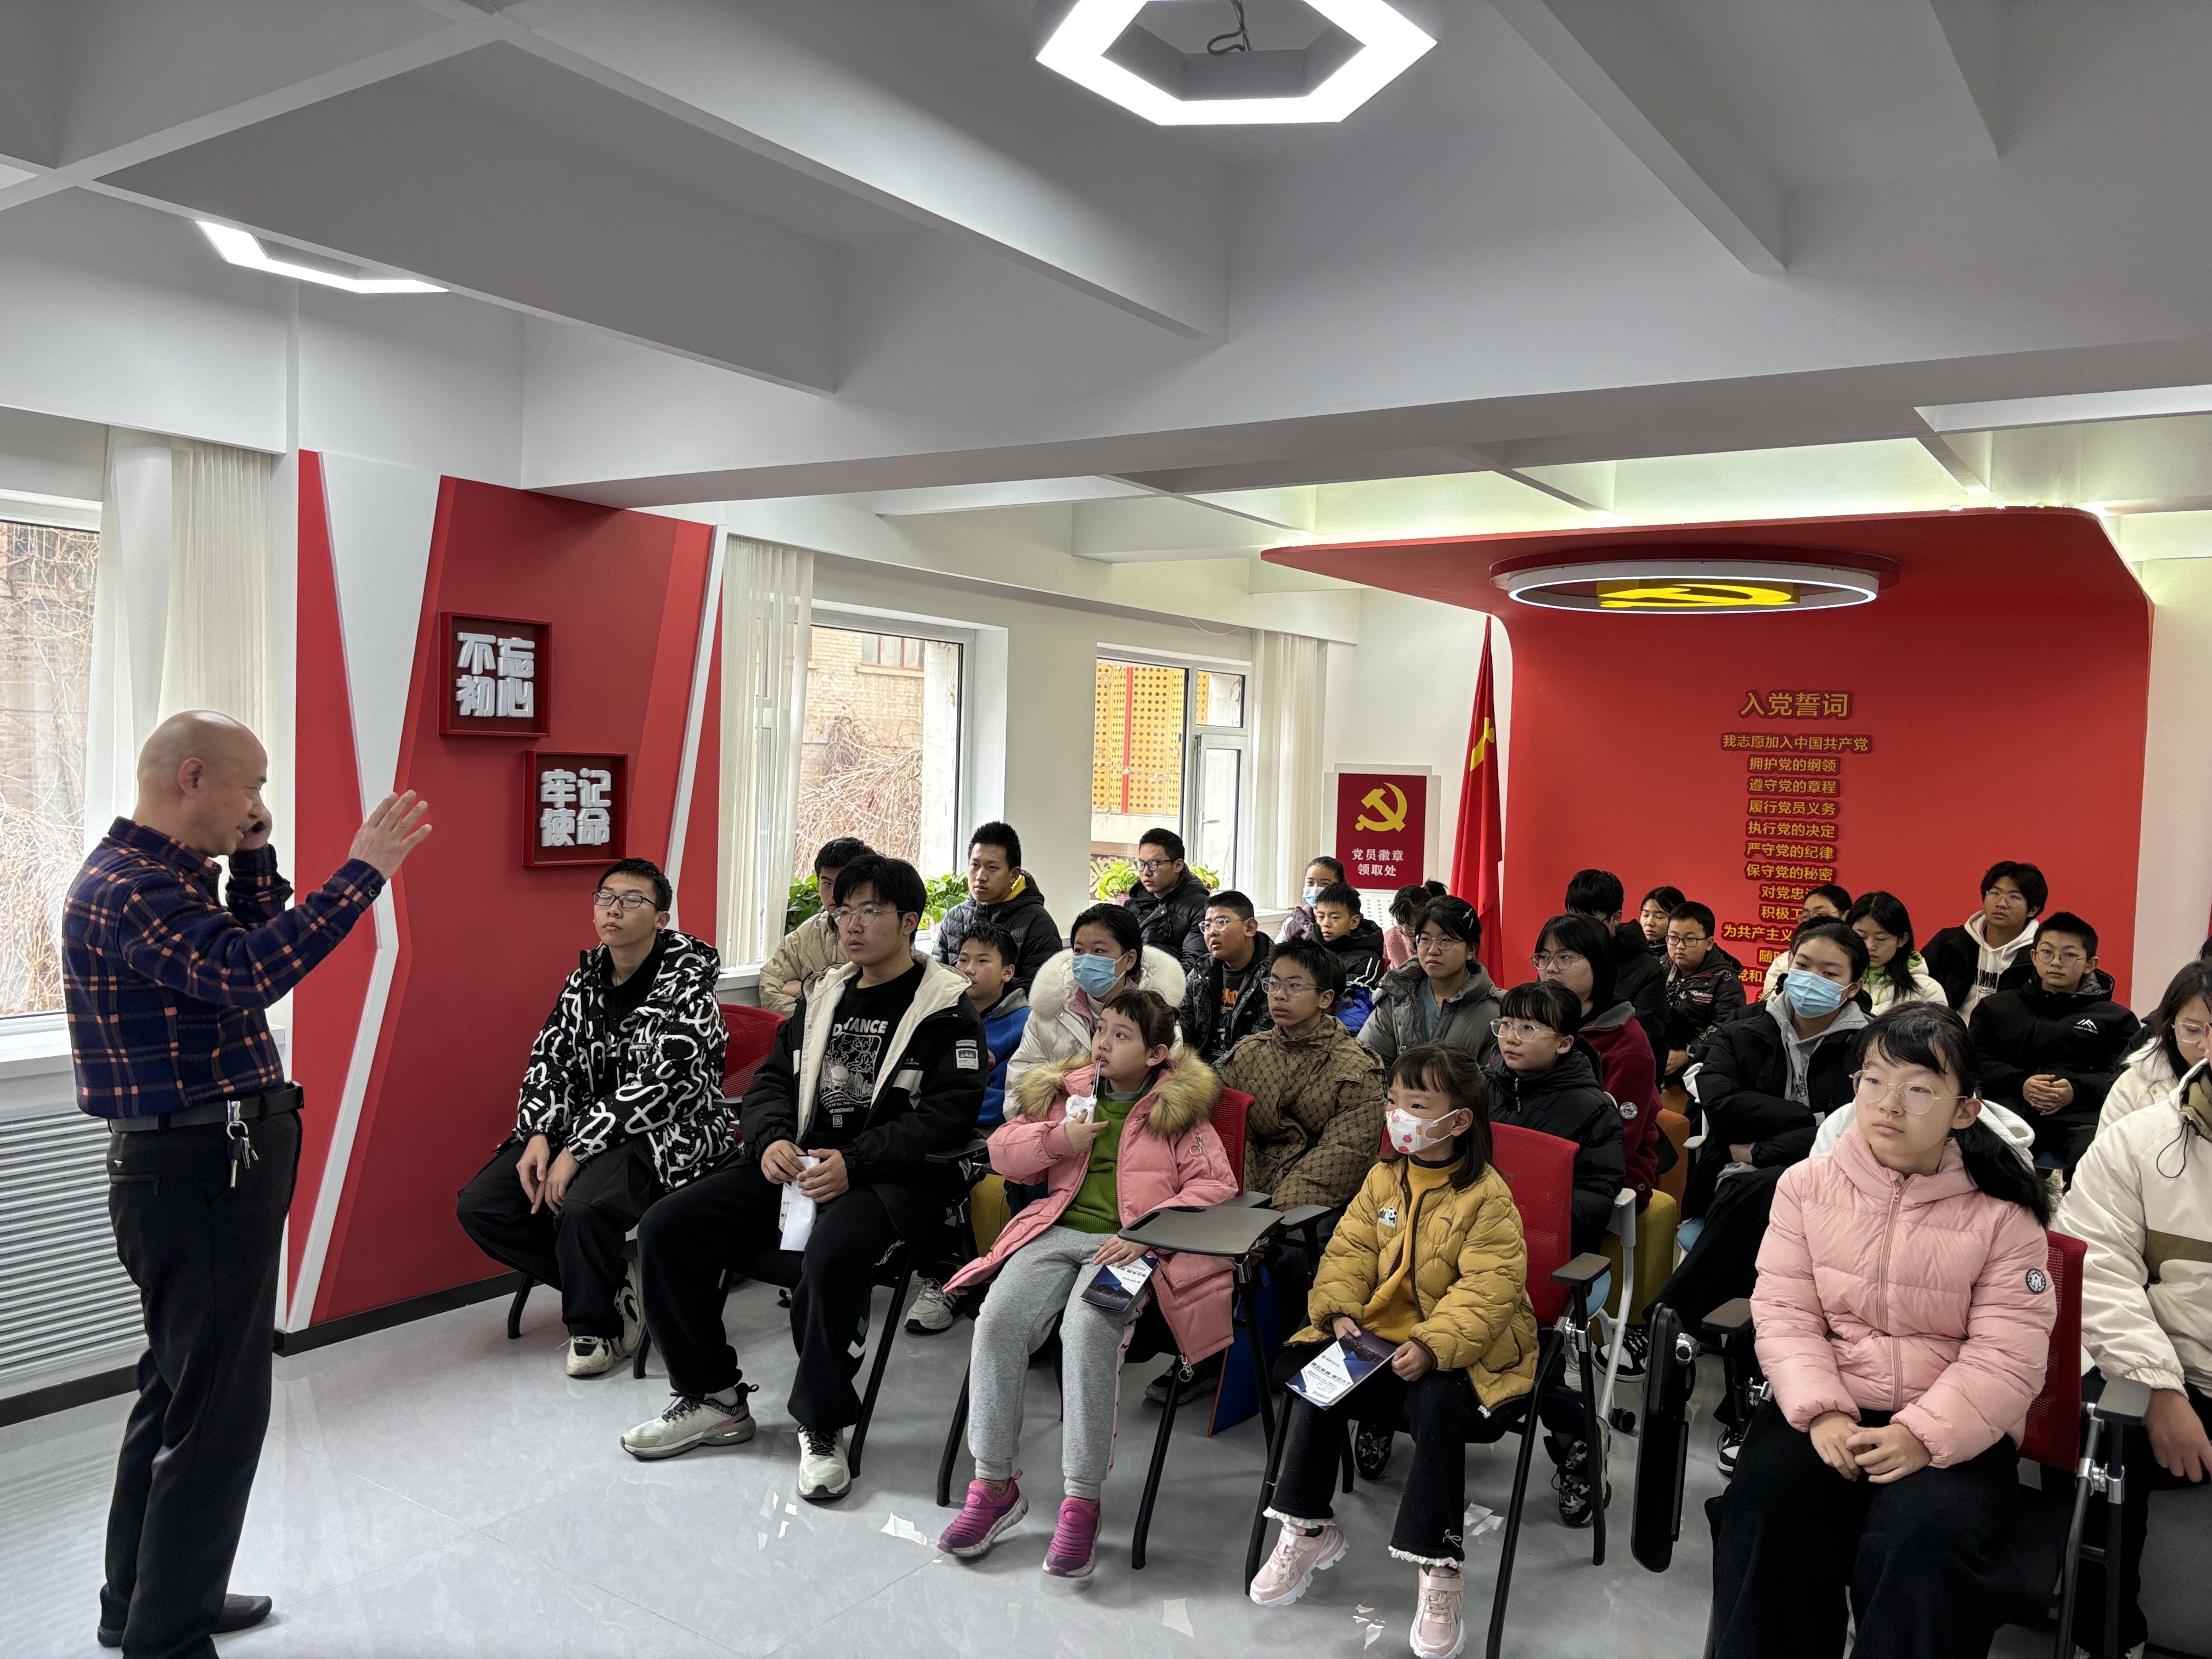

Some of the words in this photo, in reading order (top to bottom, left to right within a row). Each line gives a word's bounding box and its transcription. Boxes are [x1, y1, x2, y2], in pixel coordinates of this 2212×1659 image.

[456, 632, 535, 679] 不忘
[455, 674, 534, 718] 初心
[1740, 692, 1849, 717] 入党誓词
[1722, 734, 1868, 752] 我志愿加入中国共产党
[1749, 757, 1836, 773] 拥护党的纲领
[540, 768, 612, 808] 牢记
[1748, 778, 1836, 794] 遵守党的章程
[1748, 800, 1836, 816] 履行党员义务
[539, 807, 611, 848] 使命
[1747, 821, 1835, 838] 执行党的决定
[1351, 848, 1404, 862] 党员徽章
[1746, 843, 1834, 860] 严守党的纪律
[1357, 863, 1397, 877] 领取处
[1746, 864, 1833, 882] 保守党的秘密
[1761, 885, 1810, 900] 对党忠
[1723, 924, 1793, 942] 为共产主义
[1737, 968, 1765, 984] 党和
[832, 1017, 889, 1037] DTANCE
